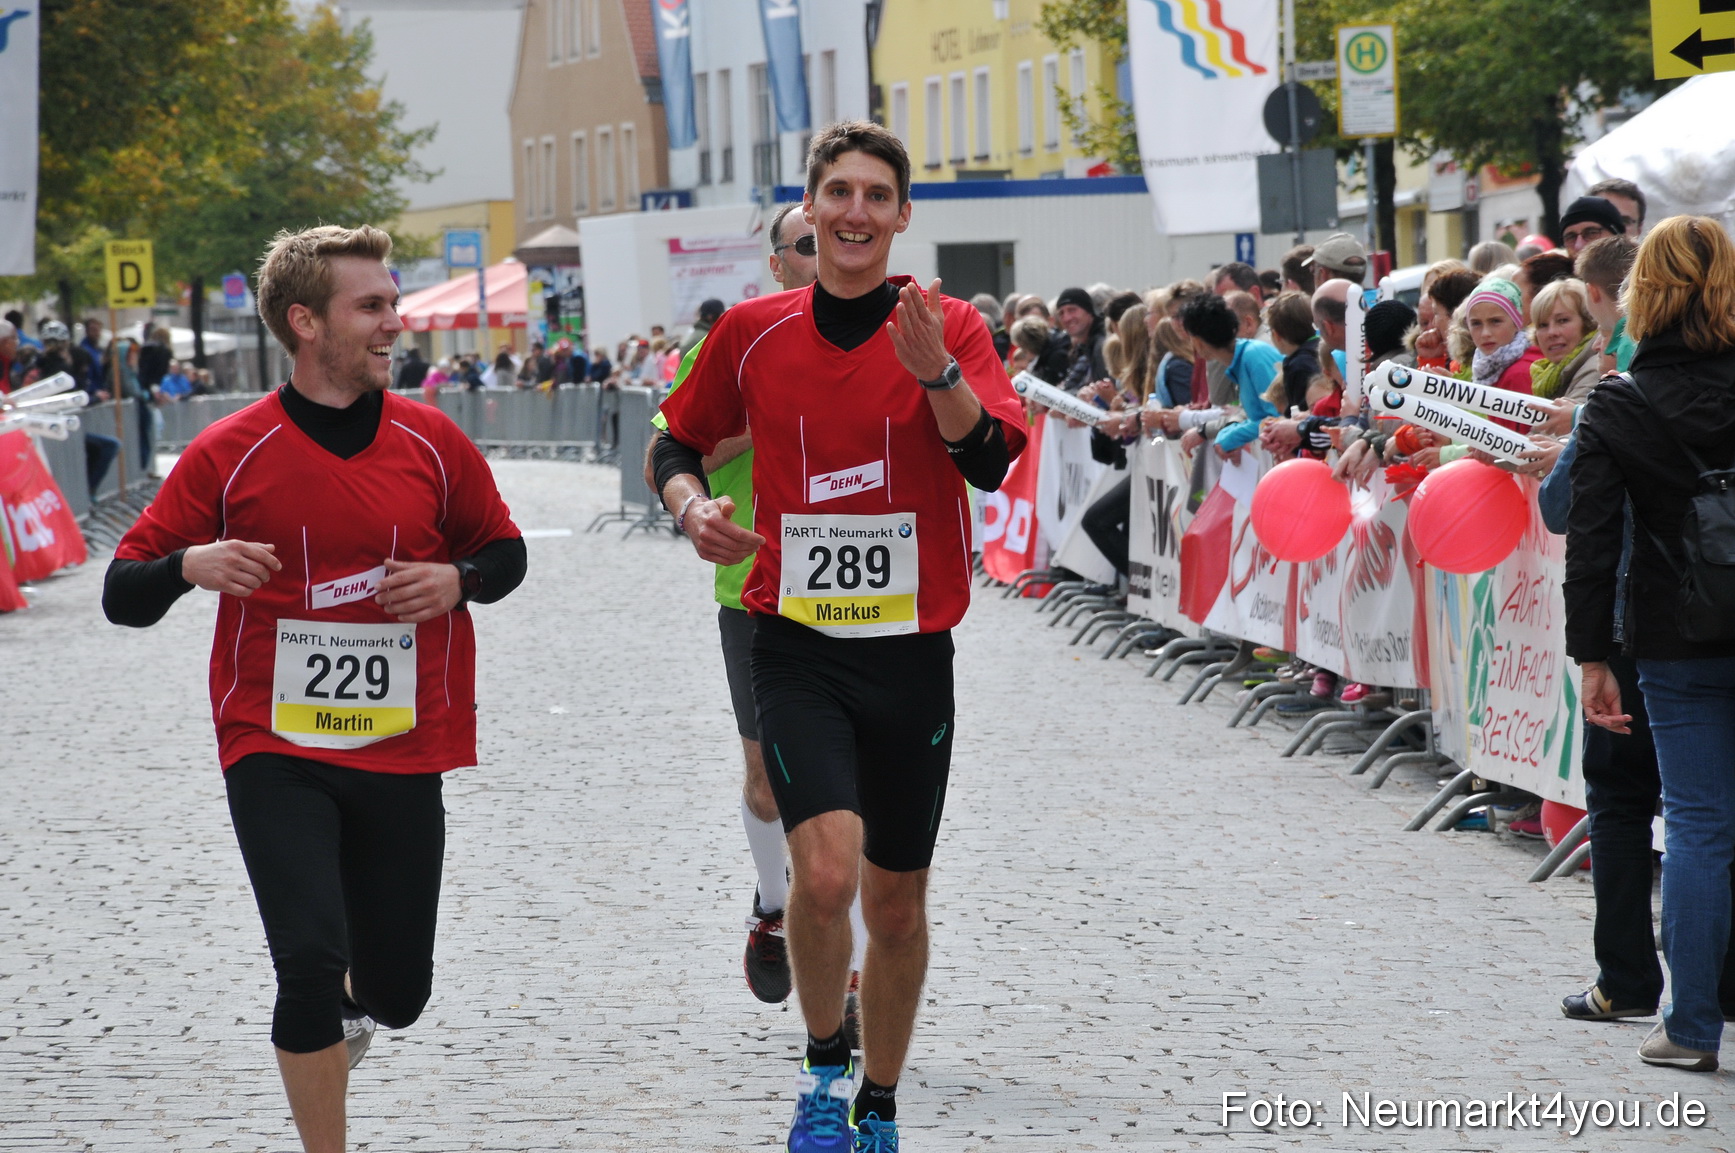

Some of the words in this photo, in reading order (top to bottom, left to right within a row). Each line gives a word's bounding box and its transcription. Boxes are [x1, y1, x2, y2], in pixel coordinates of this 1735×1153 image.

[119, 261, 142, 293] D
[1423, 376, 1477, 404] BMW
[830, 473, 863, 491] DEHN
[784, 526, 826, 539] PARTL
[829, 527, 894, 539] Neumarkt
[807, 544, 891, 590] 289
[333, 579, 368, 599] DEHN
[816, 603, 880, 621] Markus
[281, 632, 326, 647] PARTL
[330, 636, 394, 648] Neumarkt
[304, 653, 390, 701] 229
[315, 711, 373, 732] Martin
[1481, 706, 1544, 768] BESSER
